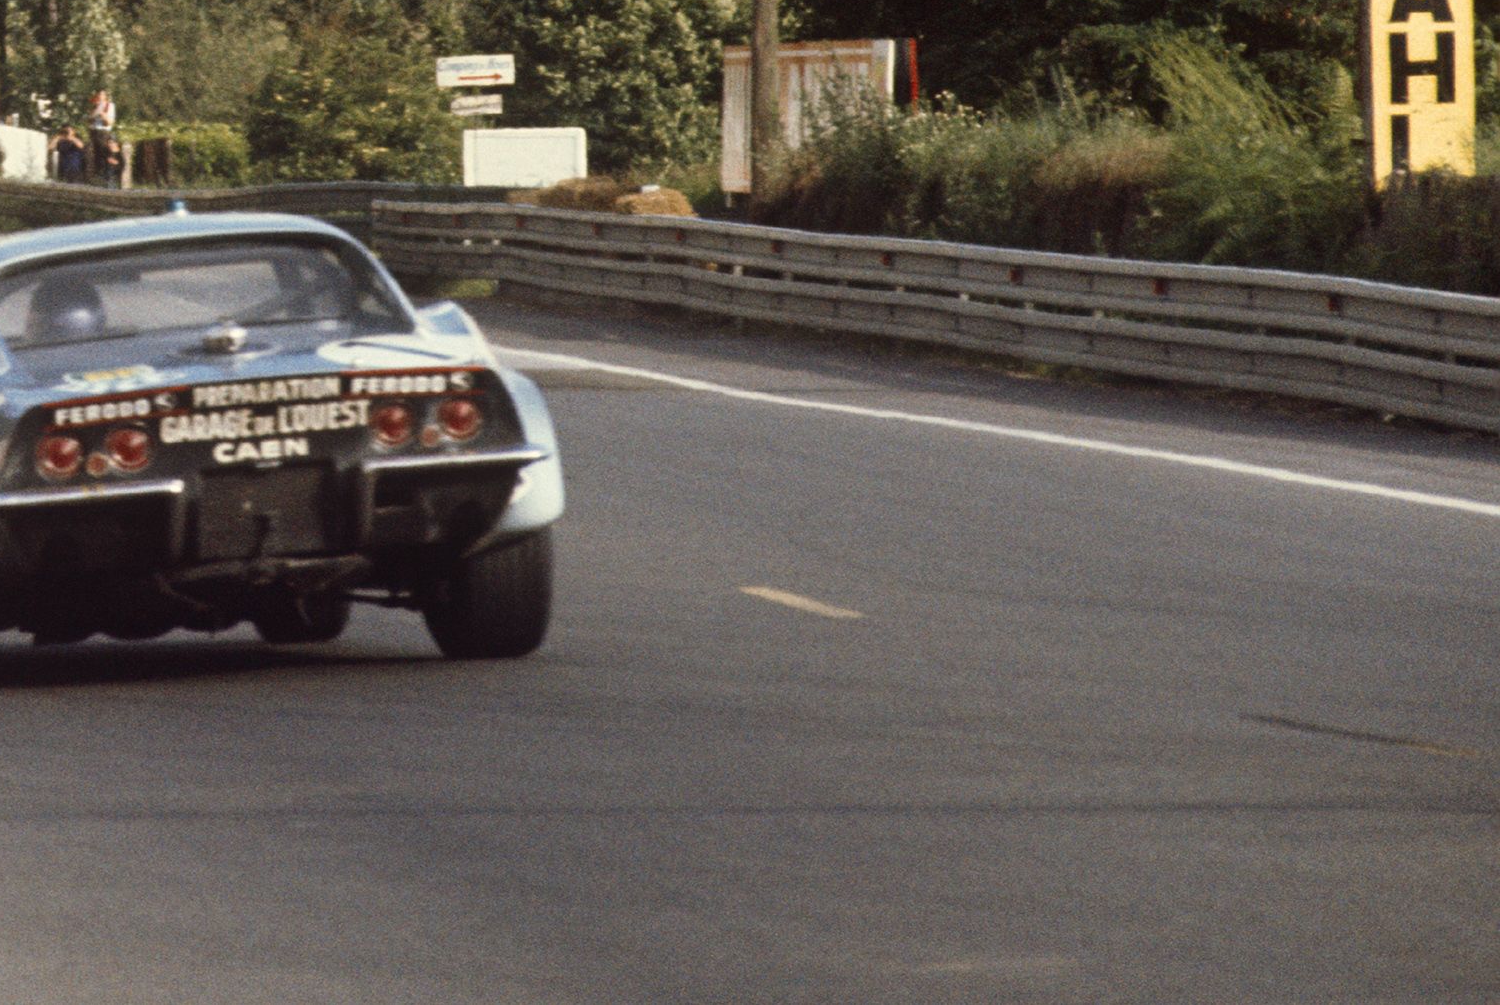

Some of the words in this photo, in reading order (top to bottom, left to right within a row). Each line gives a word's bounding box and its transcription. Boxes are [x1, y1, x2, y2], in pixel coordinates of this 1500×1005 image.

[351, 375, 447, 394] FERODO
[55, 399, 151, 426] FERODO
[160, 408, 254, 443] GARAGE
[212, 437, 309, 464] CAEN
